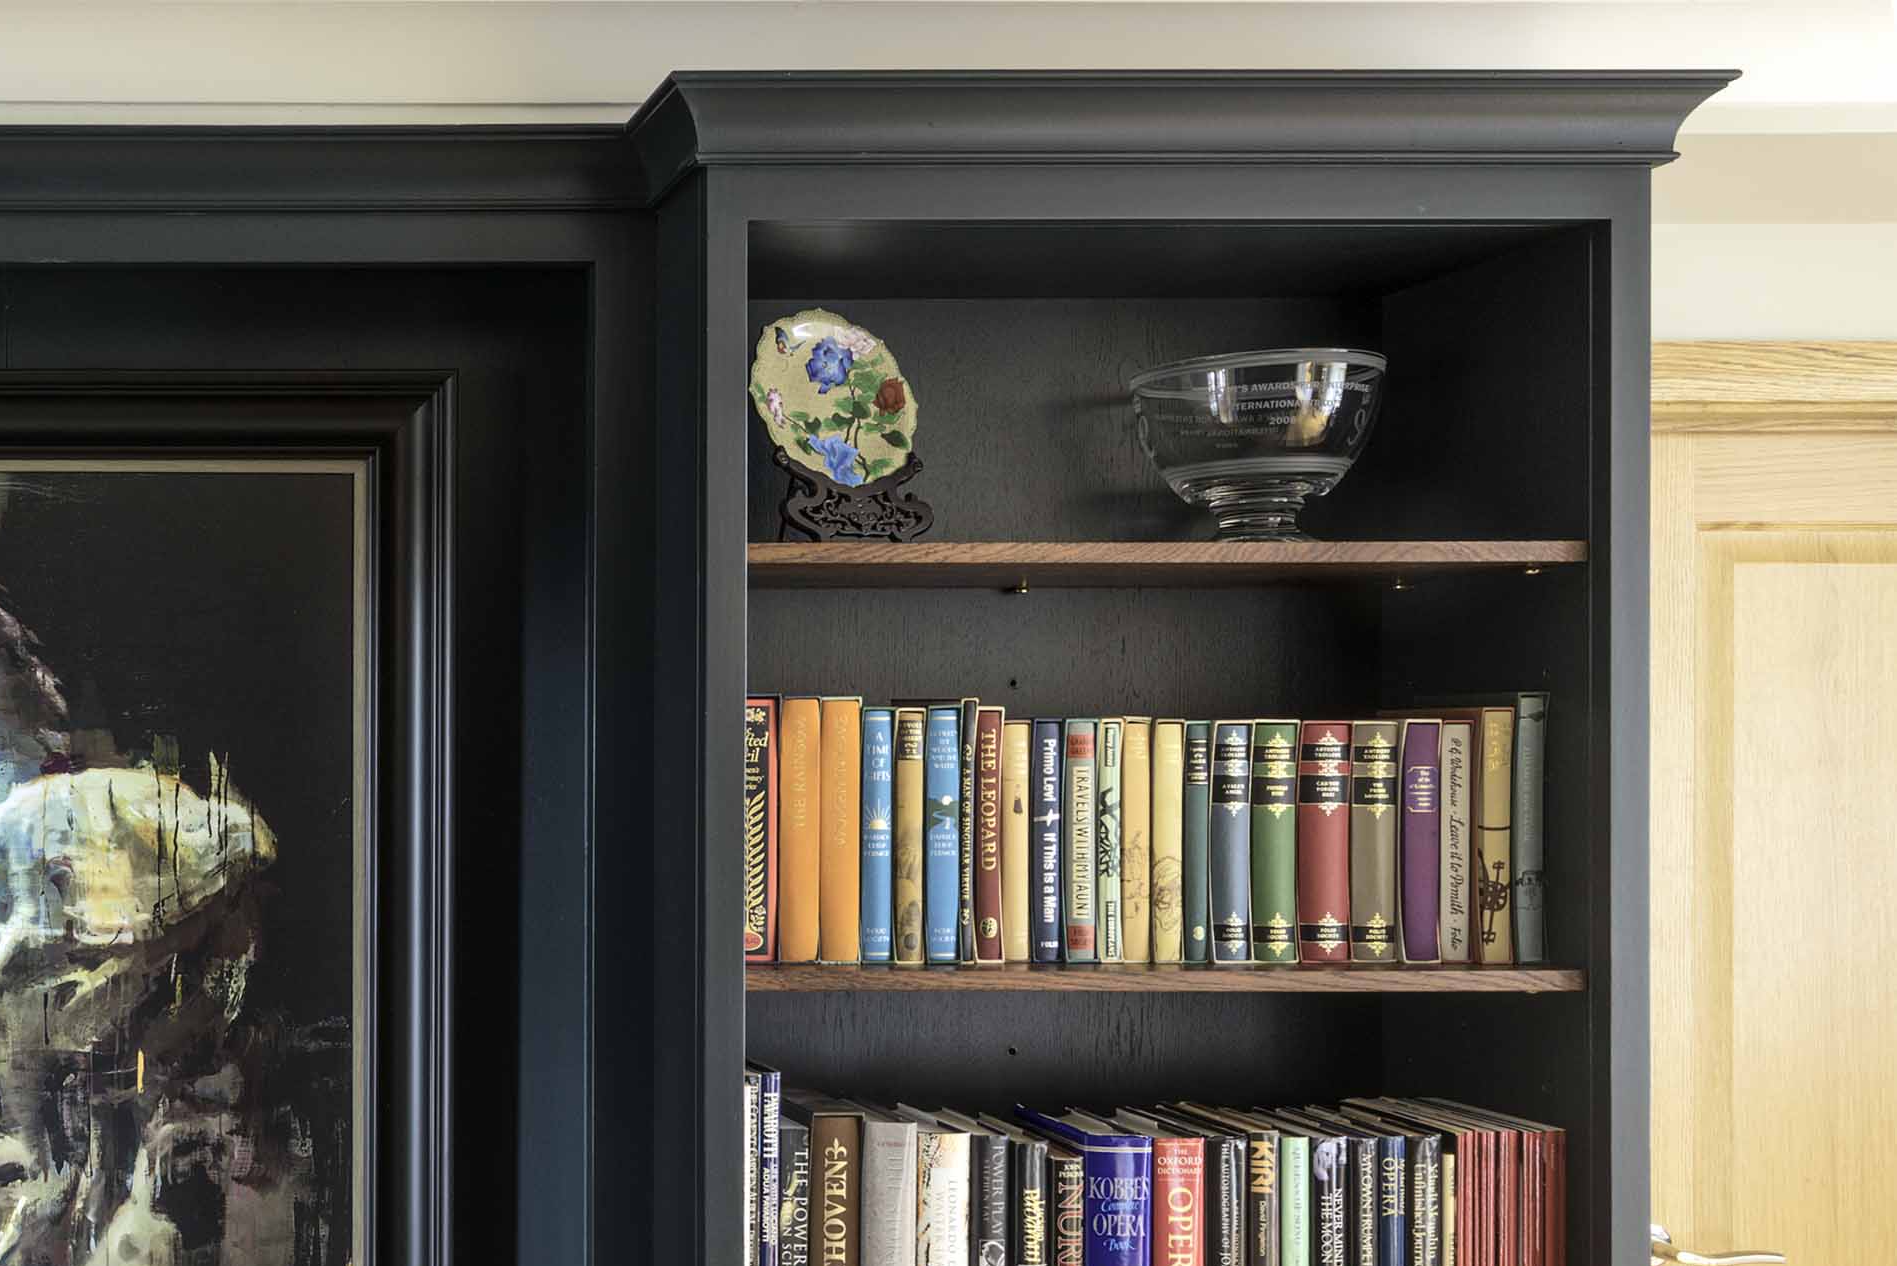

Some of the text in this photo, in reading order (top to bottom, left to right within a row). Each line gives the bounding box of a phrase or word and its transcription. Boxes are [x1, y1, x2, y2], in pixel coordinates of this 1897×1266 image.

[981, 728, 998, 872] THE LEOPARD
[1043, 738, 1057, 924] Primo Levi If This is a Man
[1075, 768, 1091, 919] TRAVELS WITH MY AUNT
[792, 1148, 808, 1189] THE
[1251, 1140, 1276, 1194] KIRI
[792, 1195, 808, 1266] POWER
[1092, 1213, 1146, 1238] OPERA
